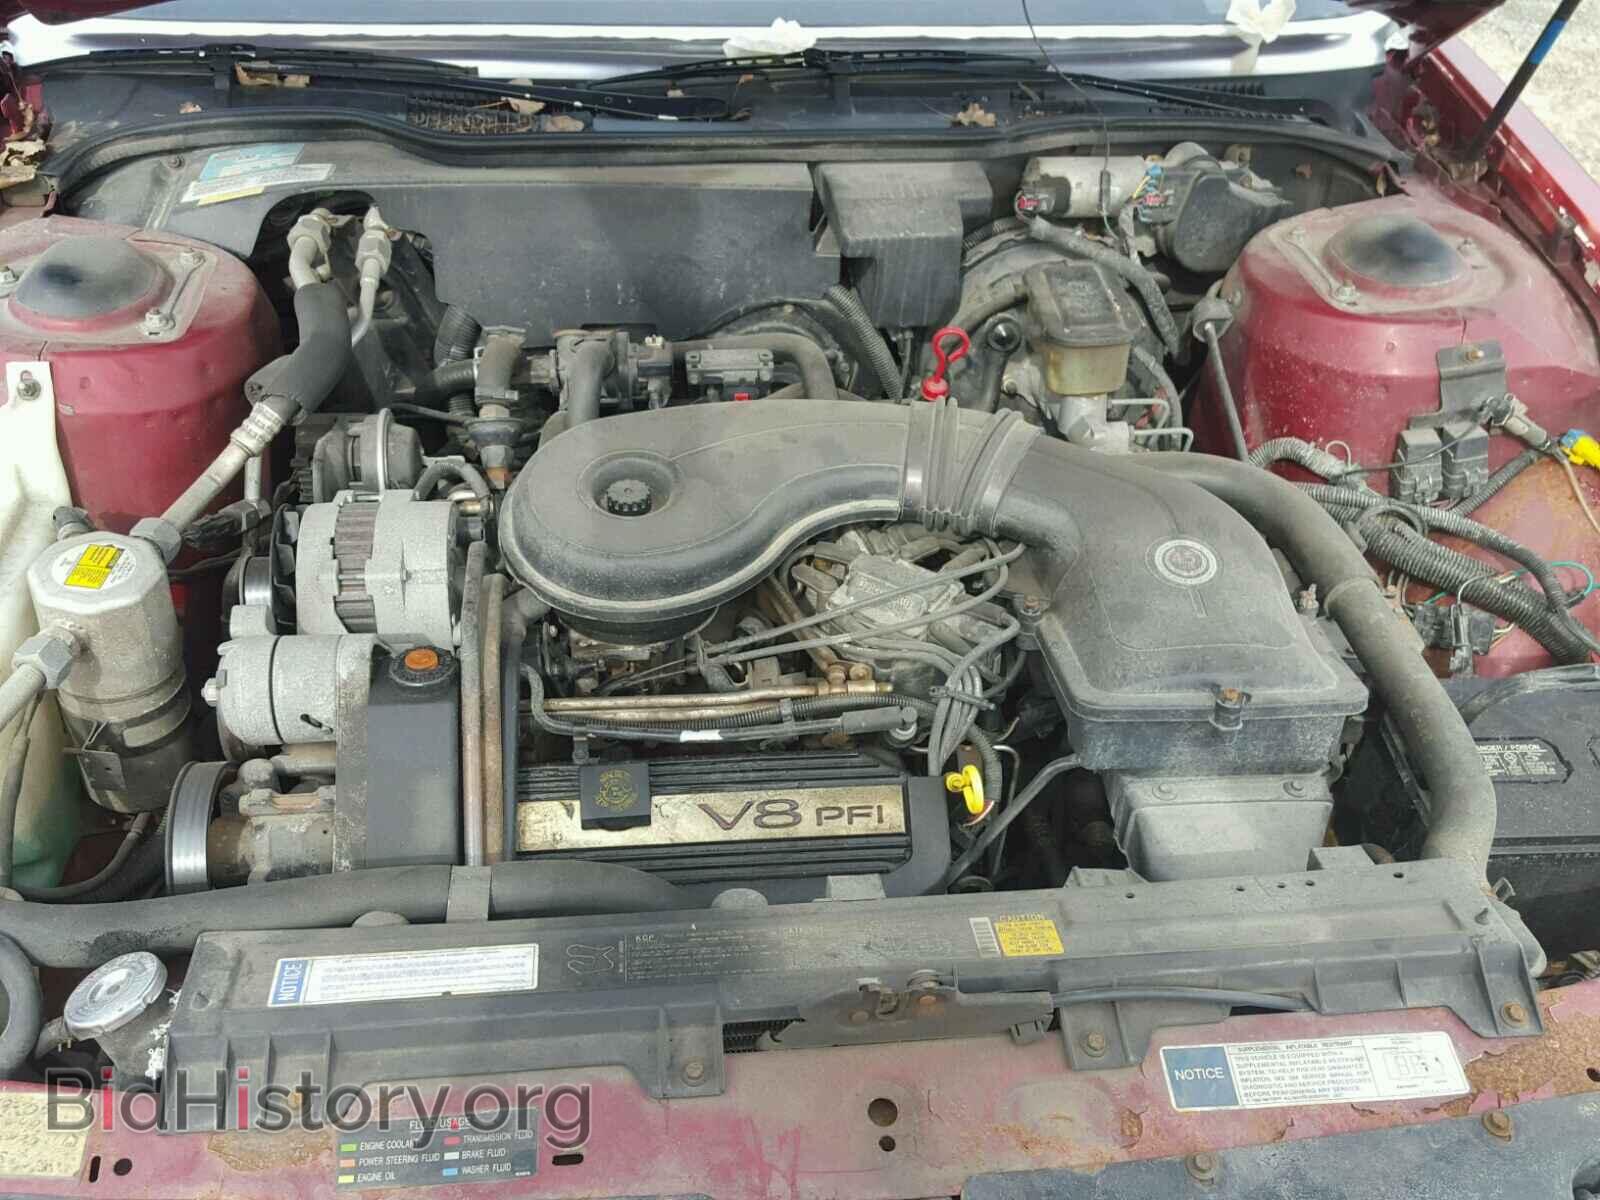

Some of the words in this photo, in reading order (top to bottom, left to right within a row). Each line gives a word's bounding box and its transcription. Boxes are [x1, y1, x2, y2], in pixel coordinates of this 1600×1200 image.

[698, 798, 802, 831] V8
[815, 804, 884, 826] PFI
[278, 962, 303, 1001] NOTICE
[1174, 1067, 1225, 1081] NOTICE
[410, 1119, 436, 1130] FLD
[463, 1131, 512, 1144] TRANSMISSION
[514, 1129, 533, 1140] FLUID
[360, 1141, 385, 1151] ENGINE
[358, 1156, 384, 1167] POWER
[385, 1154, 419, 1165] STEERING
[421, 1152, 440, 1162] FLUID
[461, 1149, 485, 1160] BRAKE
[487, 1147, 506, 1158] FLUID
[462, 1163, 490, 1175] WASHER
[492, 1162, 512, 1173] FLUID
[357, 1172, 383, 1183] ENGINE
[384, 1171, 396, 1181] OIL
